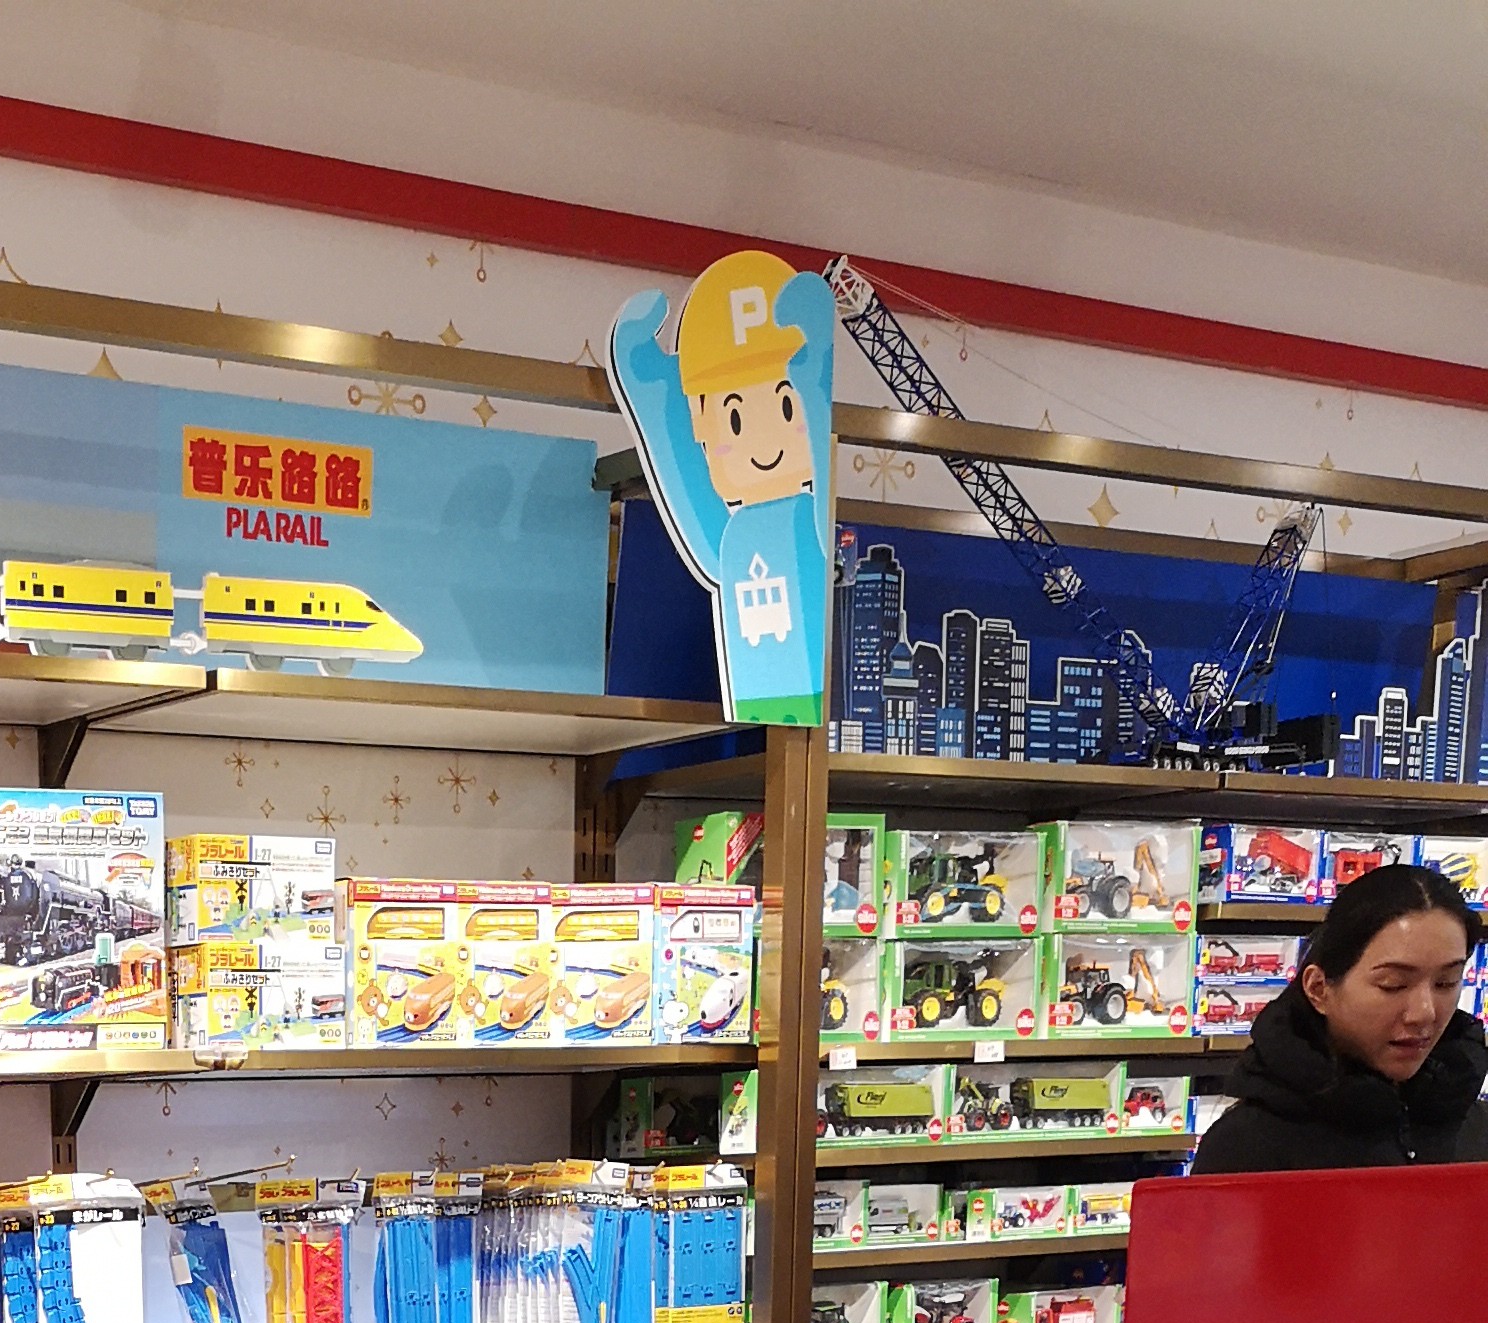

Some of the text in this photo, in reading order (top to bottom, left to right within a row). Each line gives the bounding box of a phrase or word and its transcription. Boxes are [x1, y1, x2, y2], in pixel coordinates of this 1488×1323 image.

[731, 286, 768, 345] P
[226, 507, 328, 547] PLARAIL
[199, 843, 247, 860] プラレール
[213, 865, 260, 878] ふみきりセット
[224, 972, 271, 985] ふみきりセット
